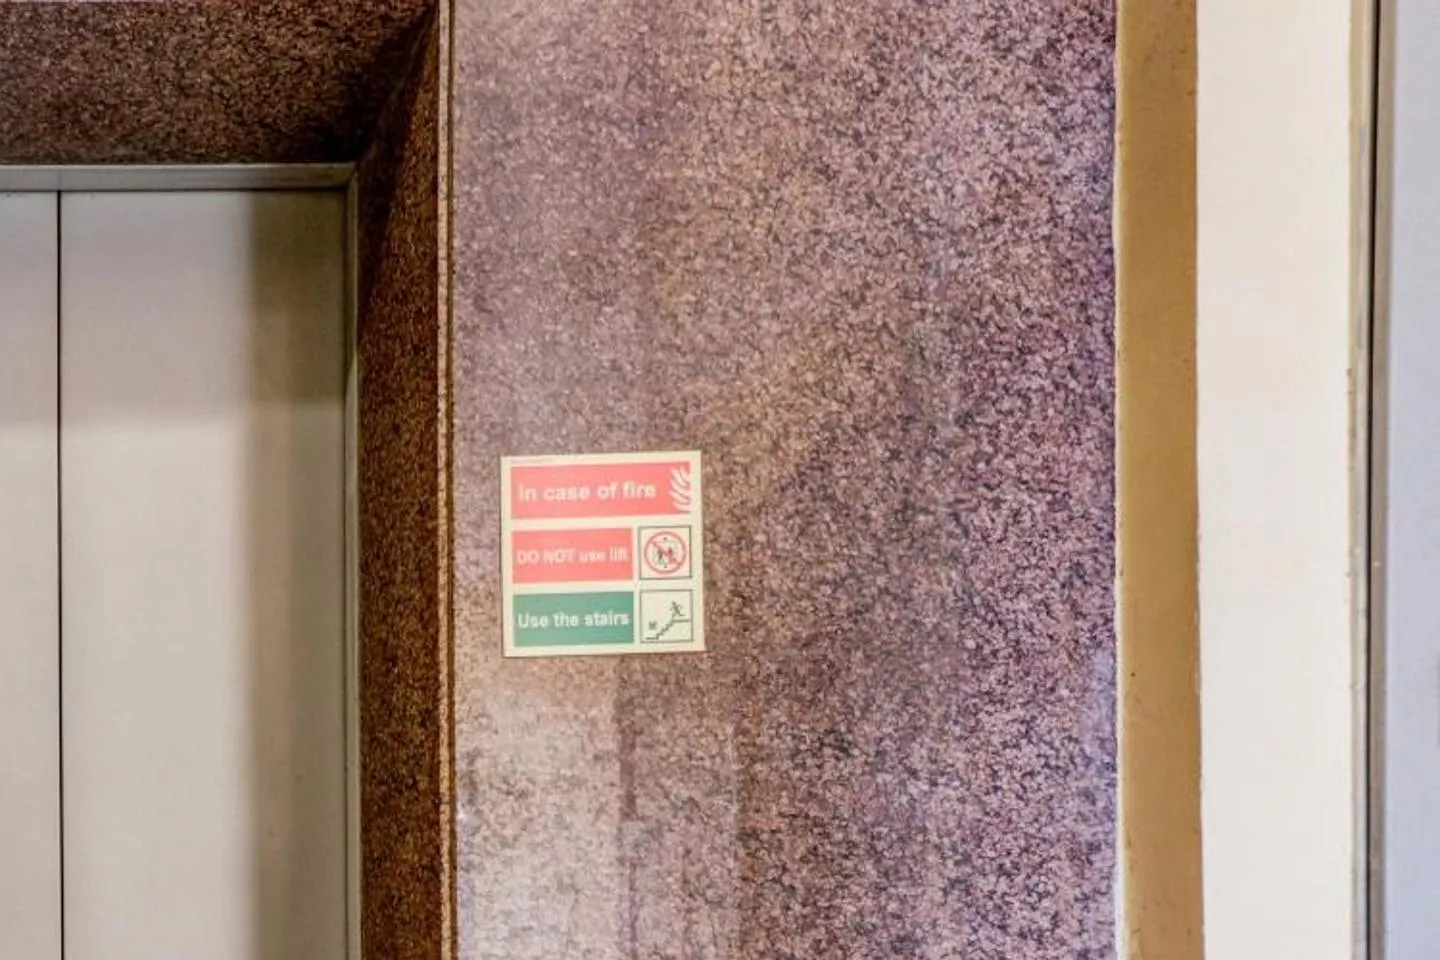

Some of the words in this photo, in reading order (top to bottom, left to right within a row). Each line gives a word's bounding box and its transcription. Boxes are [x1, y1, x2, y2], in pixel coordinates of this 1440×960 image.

[518, 484, 537, 502] In
[544, 485, 590, 501] case
[596, 482, 615, 499] of
[623, 481, 656, 498] fire
[517, 550, 539, 565] DO
[543, 549, 576, 564] NOT
[579, 550, 606, 563] use
[518, 613, 548, 629] Use
[553, 612, 579, 628] the
[584, 610, 629, 627] stairs
